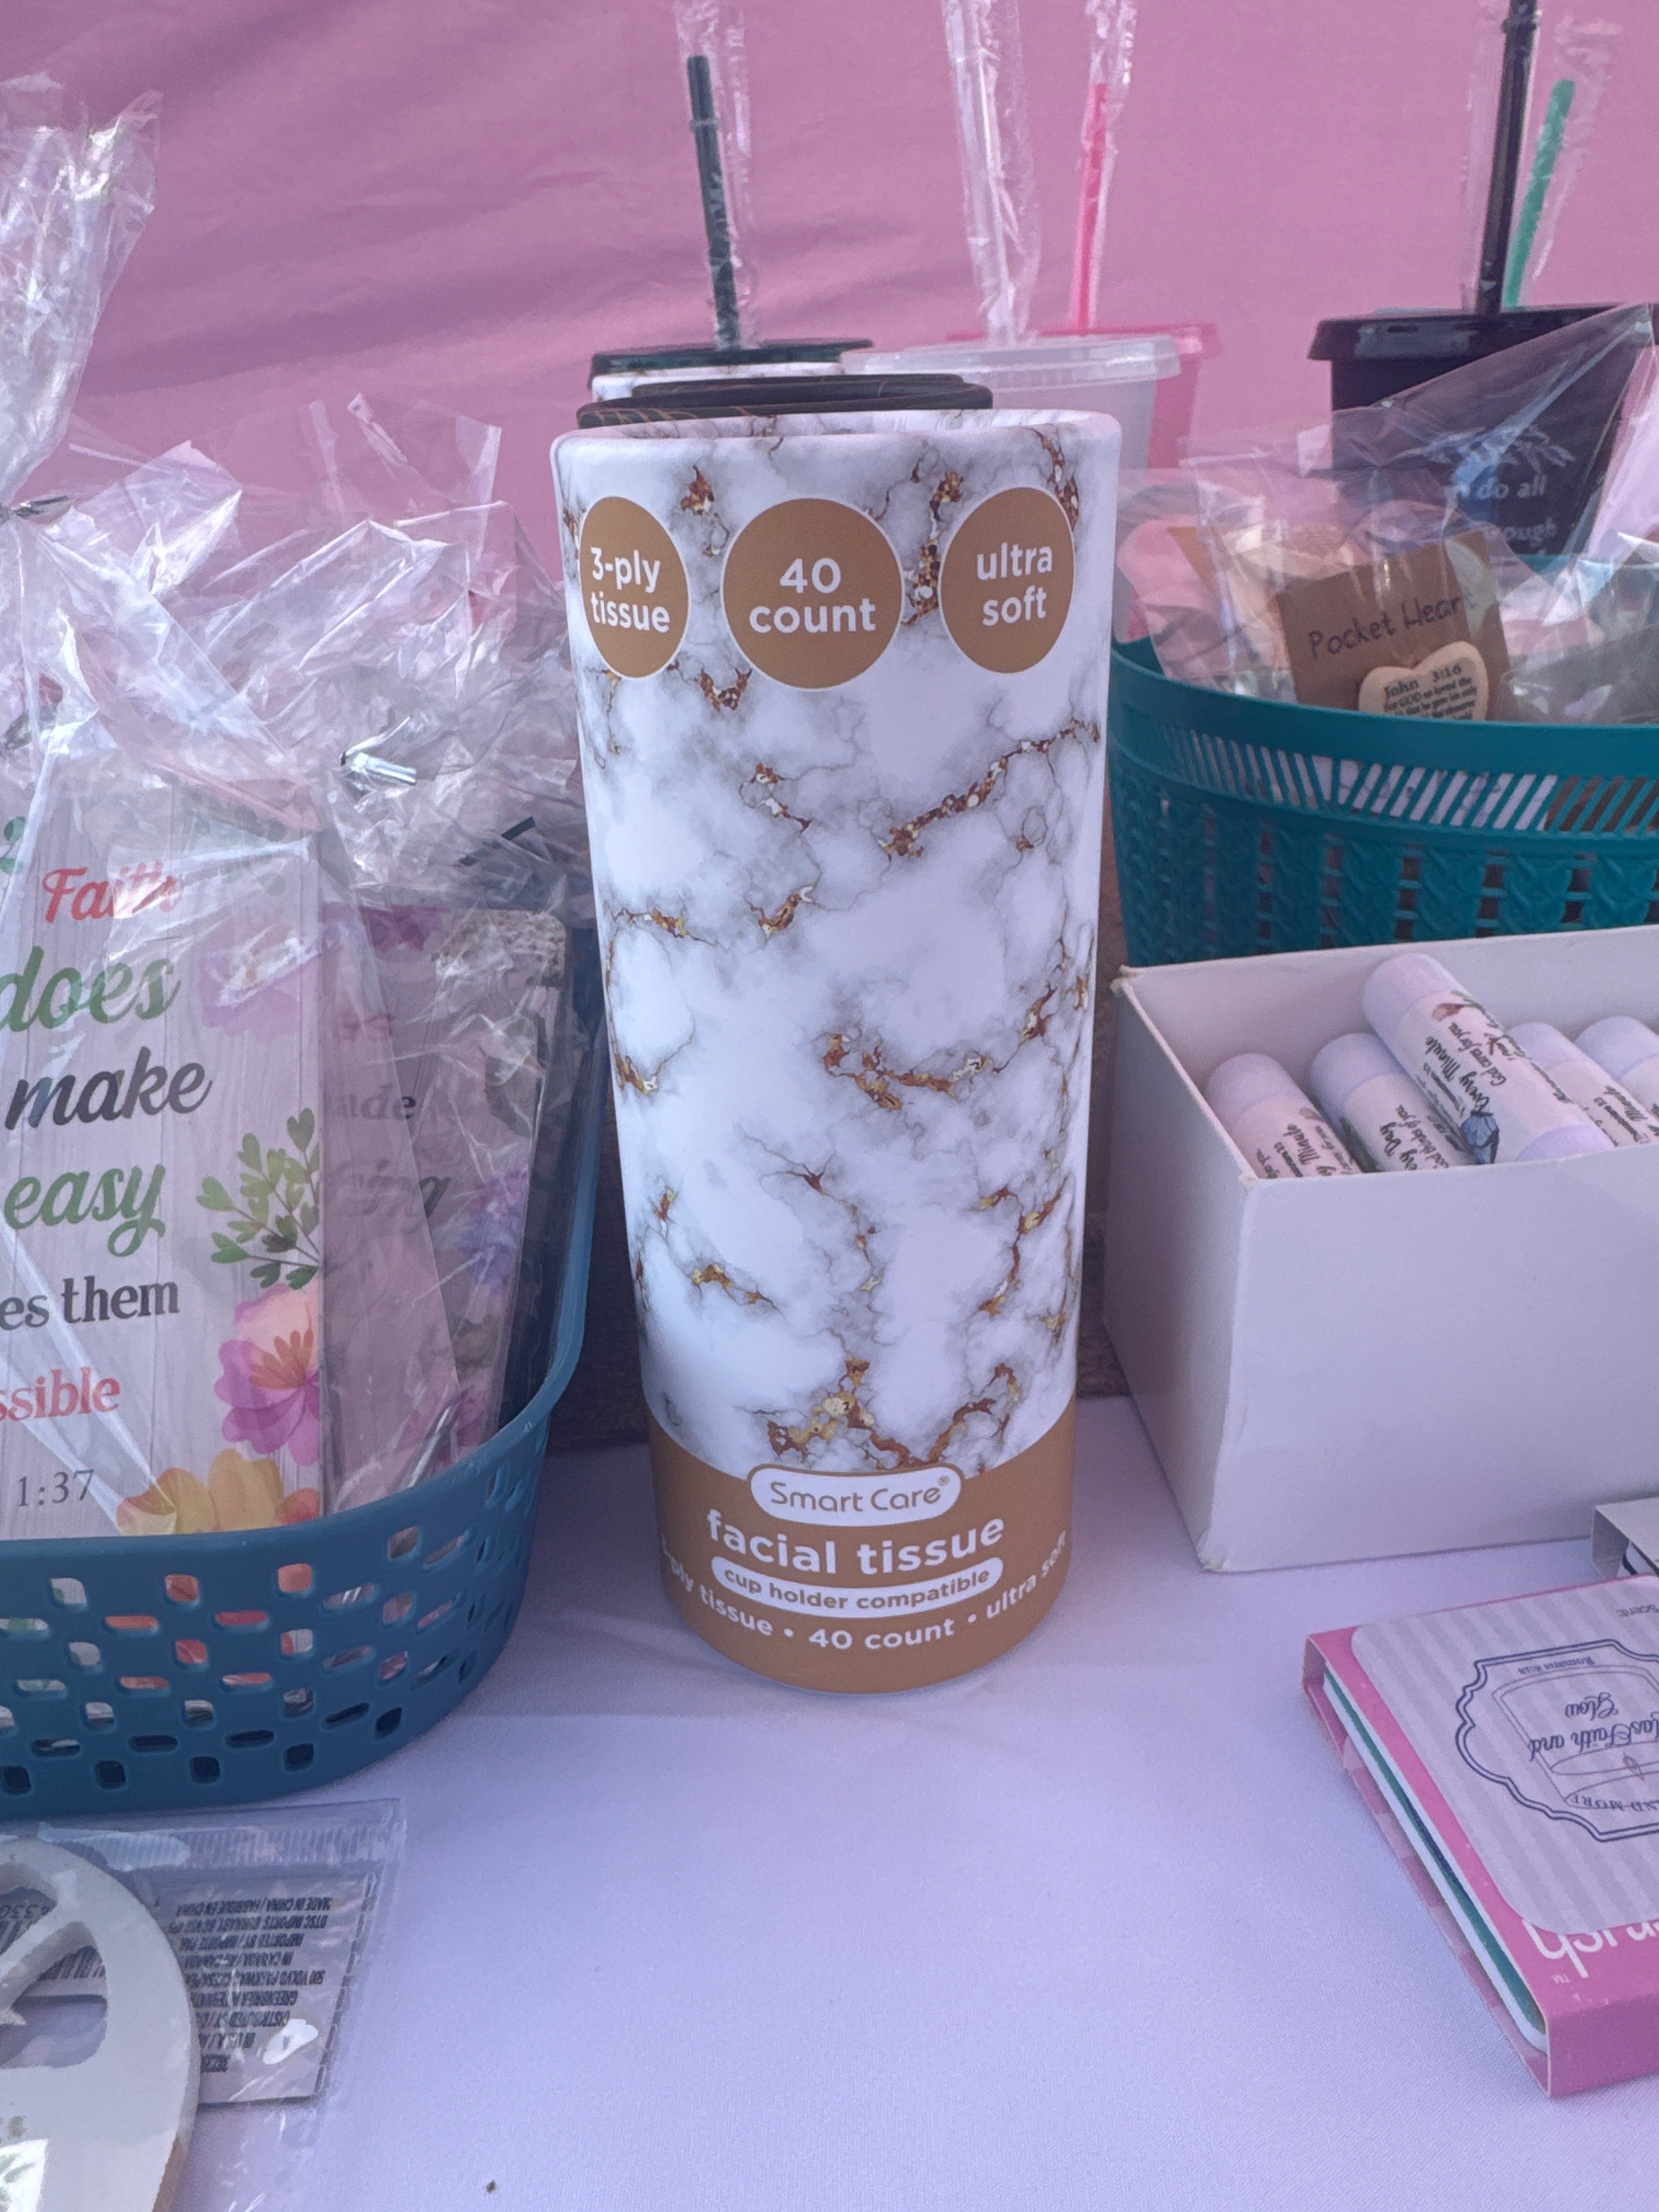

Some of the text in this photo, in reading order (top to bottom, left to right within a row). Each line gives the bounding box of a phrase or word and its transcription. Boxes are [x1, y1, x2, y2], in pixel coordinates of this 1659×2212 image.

[590, 546, 661, 594] 3-ply
[780, 557, 842, 594] 40
[976, 542, 1052, 582] ultra
[590, 591, 670, 633] tissue
[749, 597, 877, 634] count
[982, 586, 1047, 627] soft
[1308, 611, 1396, 660] Pocket
[0, 946, 182, 1032] does
[4, 1046, 213, 1131] make
[4, 1162, 165, 1257] easy
[60, 1276, 180, 1324] them
[17, 1469, 95, 1508] 1:37
[770, 1481, 864, 1513] Smart
[707, 1509, 1005, 1575] facial tissue
[724, 1567, 990, 1610] cup holder compatible
[699, 1584, 773, 1636] tissue
[809, 1628, 853, 1651] 40
[864, 1618, 954, 1650] count
[986, 1575, 1036, 1619] ultra
[1565, 1691, 1619, 1722] Glow
[1528, 1734, 1565, 1762] and
[1571, 1723, 1632, 1754] Faith
